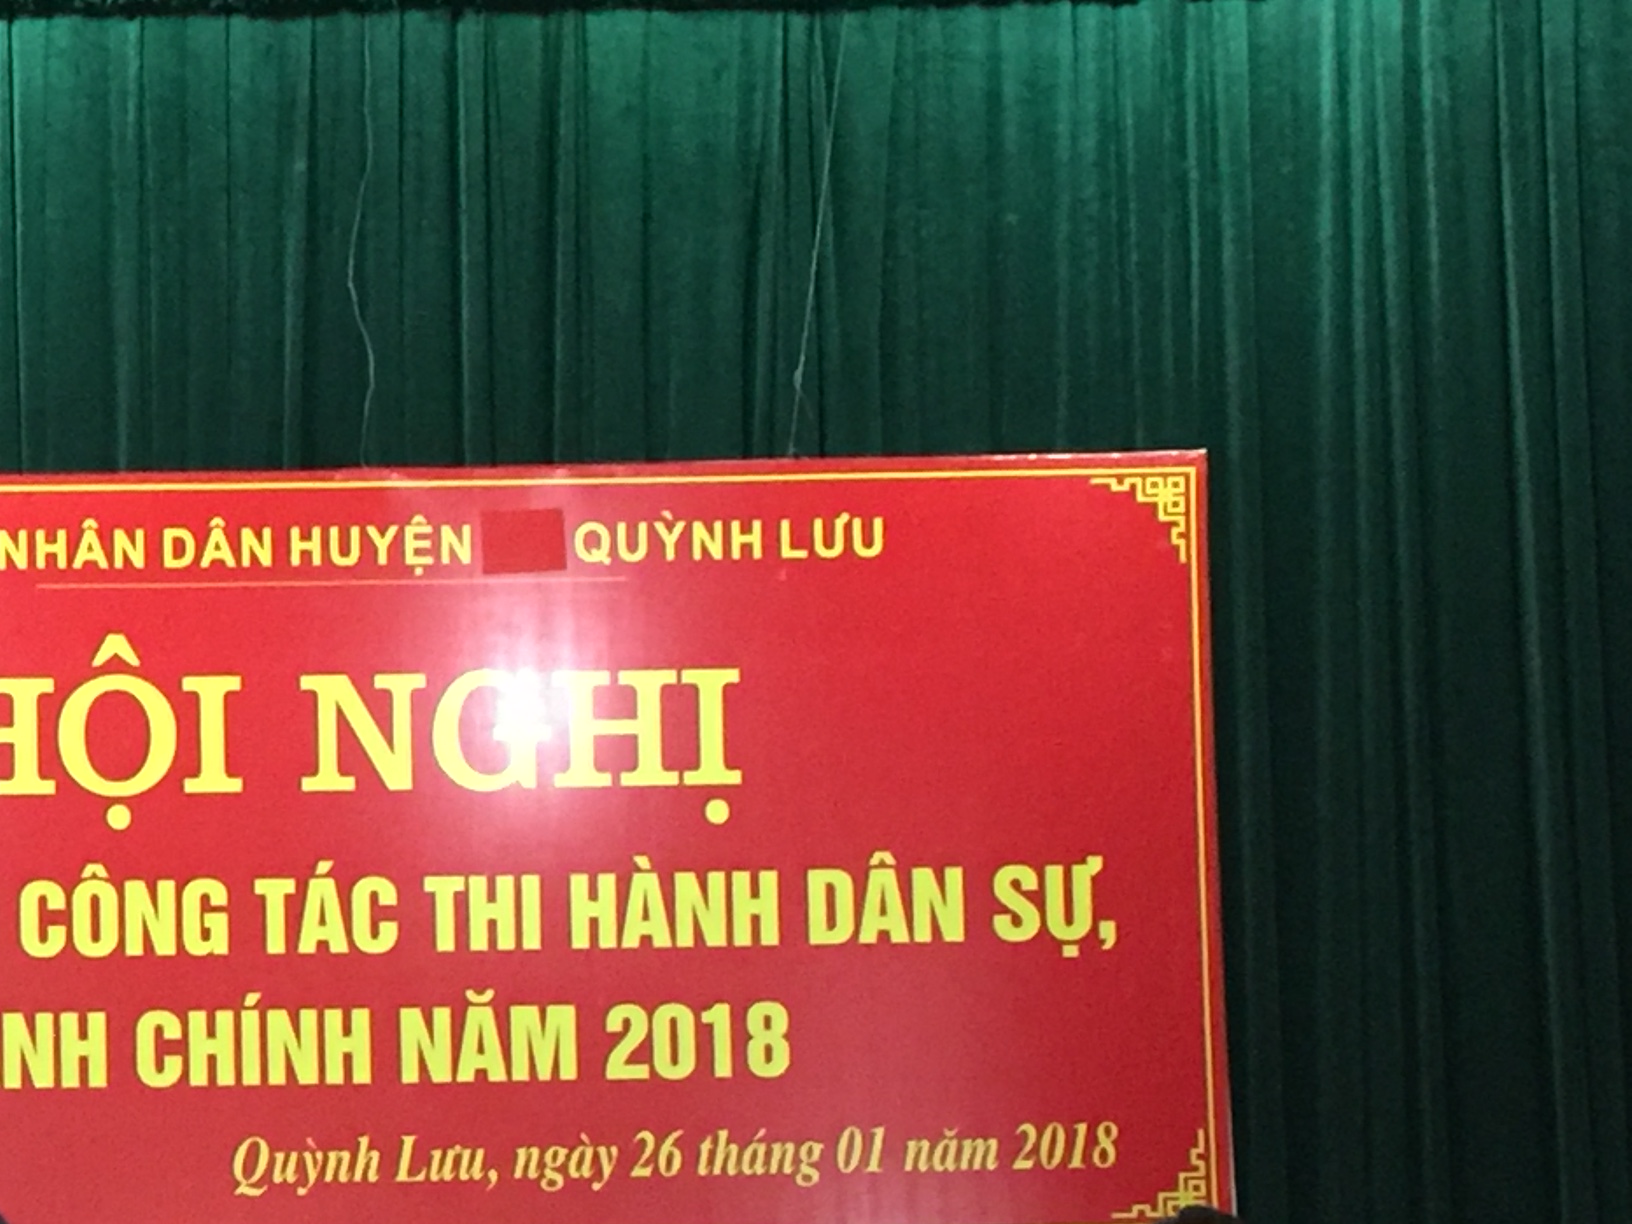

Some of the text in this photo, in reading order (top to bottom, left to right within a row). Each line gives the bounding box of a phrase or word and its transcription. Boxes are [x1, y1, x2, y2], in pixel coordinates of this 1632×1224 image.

[162, 516, 273, 569] DÂN
[289, 513, 472, 574] HUYỆN
[574, 511, 764, 565] QUỲNH
[779, 511, 884, 559] LƯU
[299, 667, 743, 825] NGHỊ
[19, 862, 229, 959] CÔNG
[253, 859, 399, 955] TÁC
[422, 873, 542, 953] THI
[569, 854, 780, 950] HÀNH
[806, 850, 965, 946] DÂN
[992, 855, 1117, 958] SỰ,
[135, 991, 372, 1089] CHÍNH
[399, 988, 578, 1085] NĂM
[605, 1000, 791, 1081] 2018
[232, 1122, 1117, 1197] Quỳnh Lưu, ngày 26 tháng 01 năm 2018
